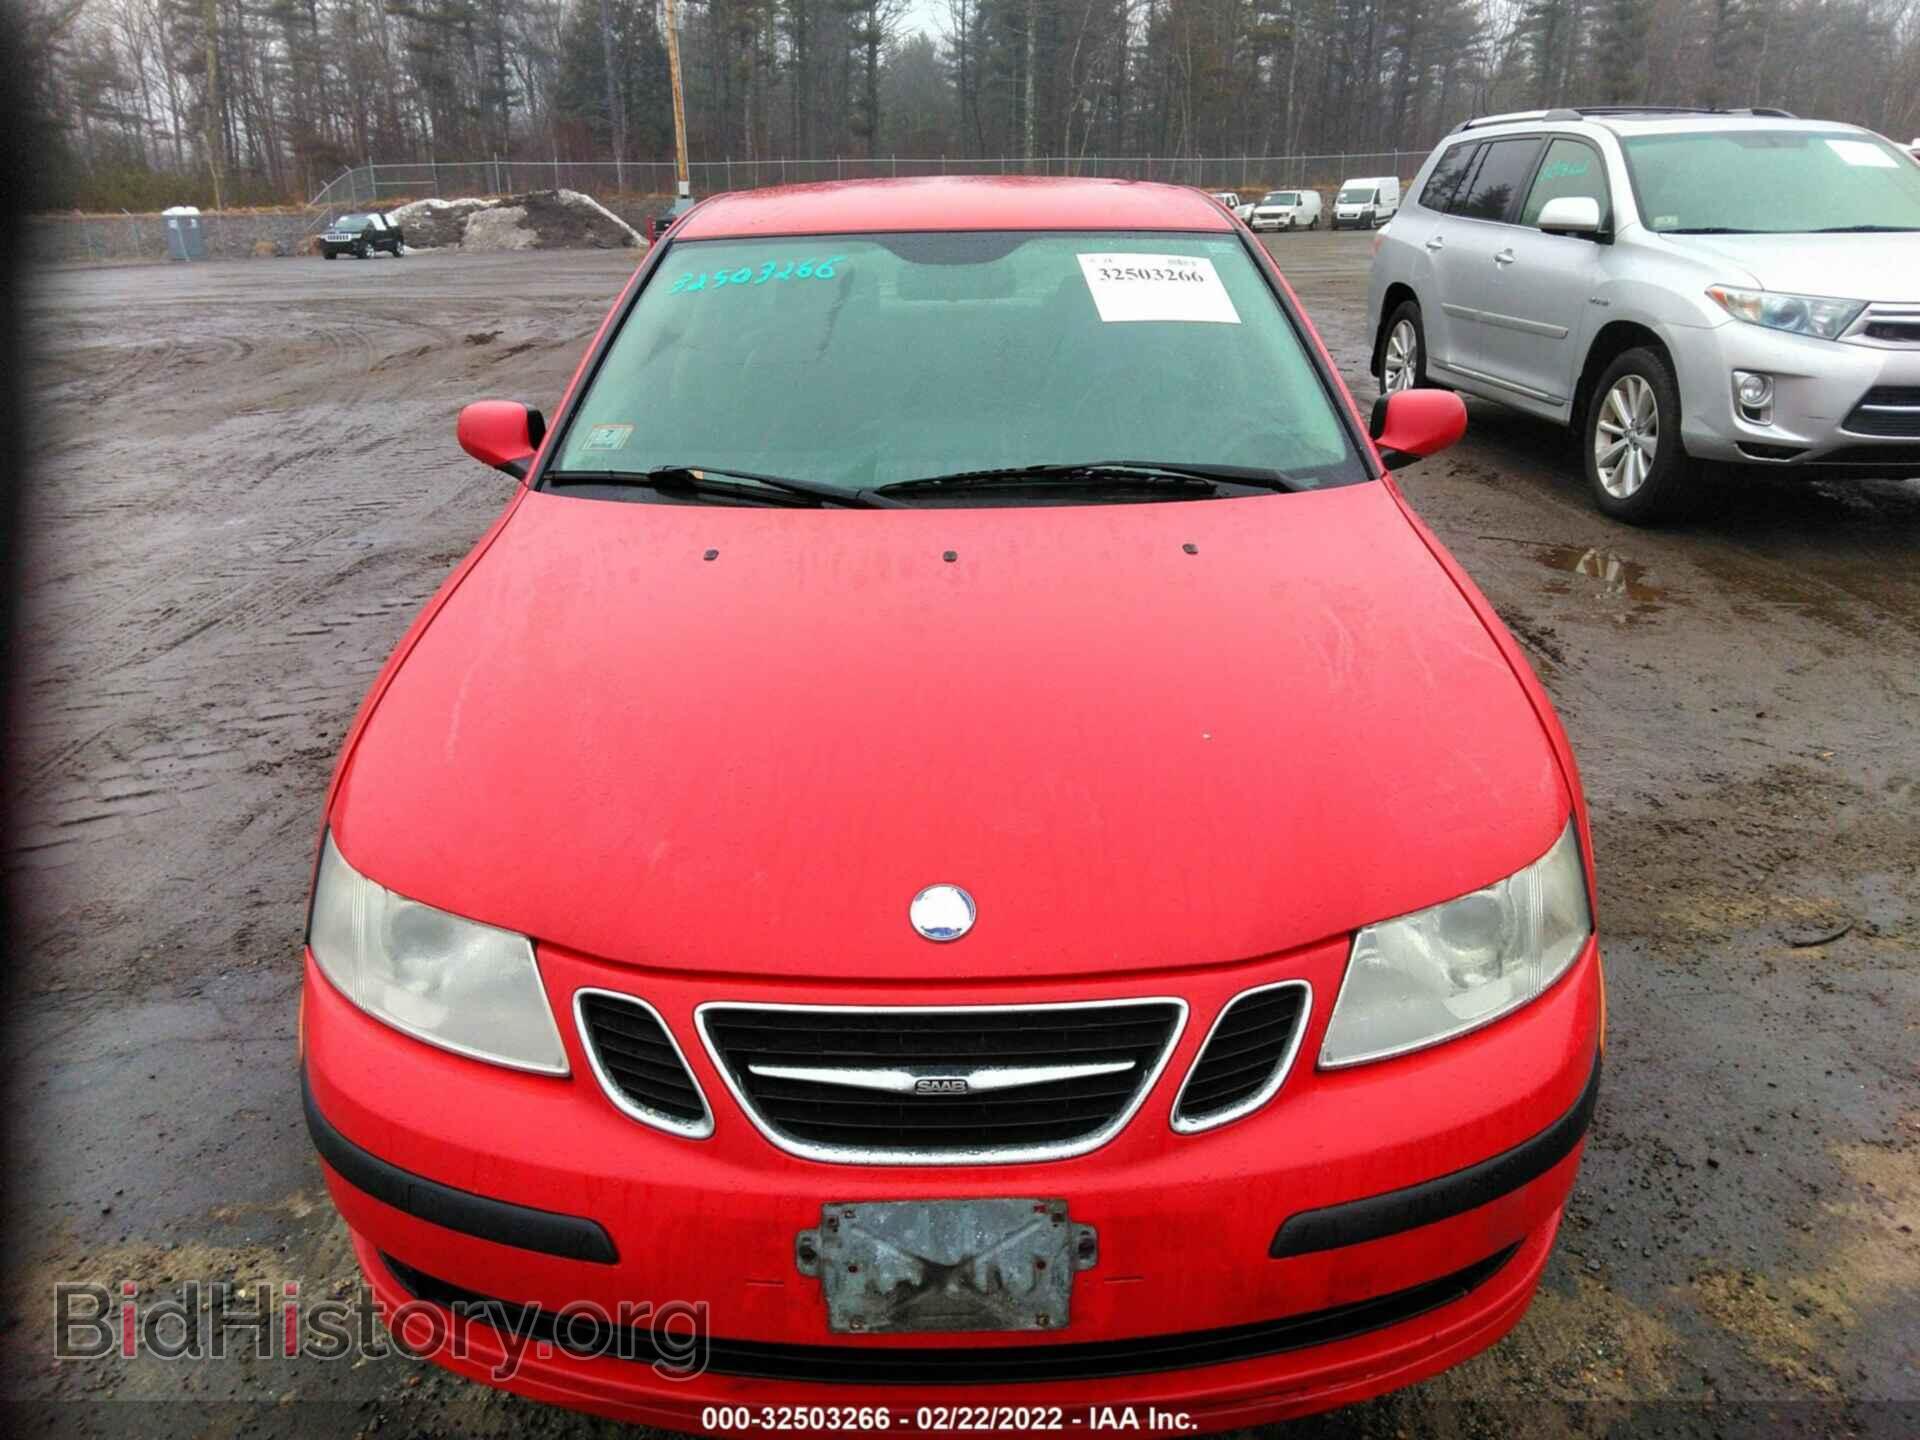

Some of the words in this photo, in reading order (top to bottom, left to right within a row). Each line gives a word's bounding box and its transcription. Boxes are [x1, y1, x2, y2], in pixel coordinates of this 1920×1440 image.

[665, 255, 847, 295] 32503266
[1099, 267, 1204, 282] 32503266
[917, 1080, 966, 1092] SAAB
